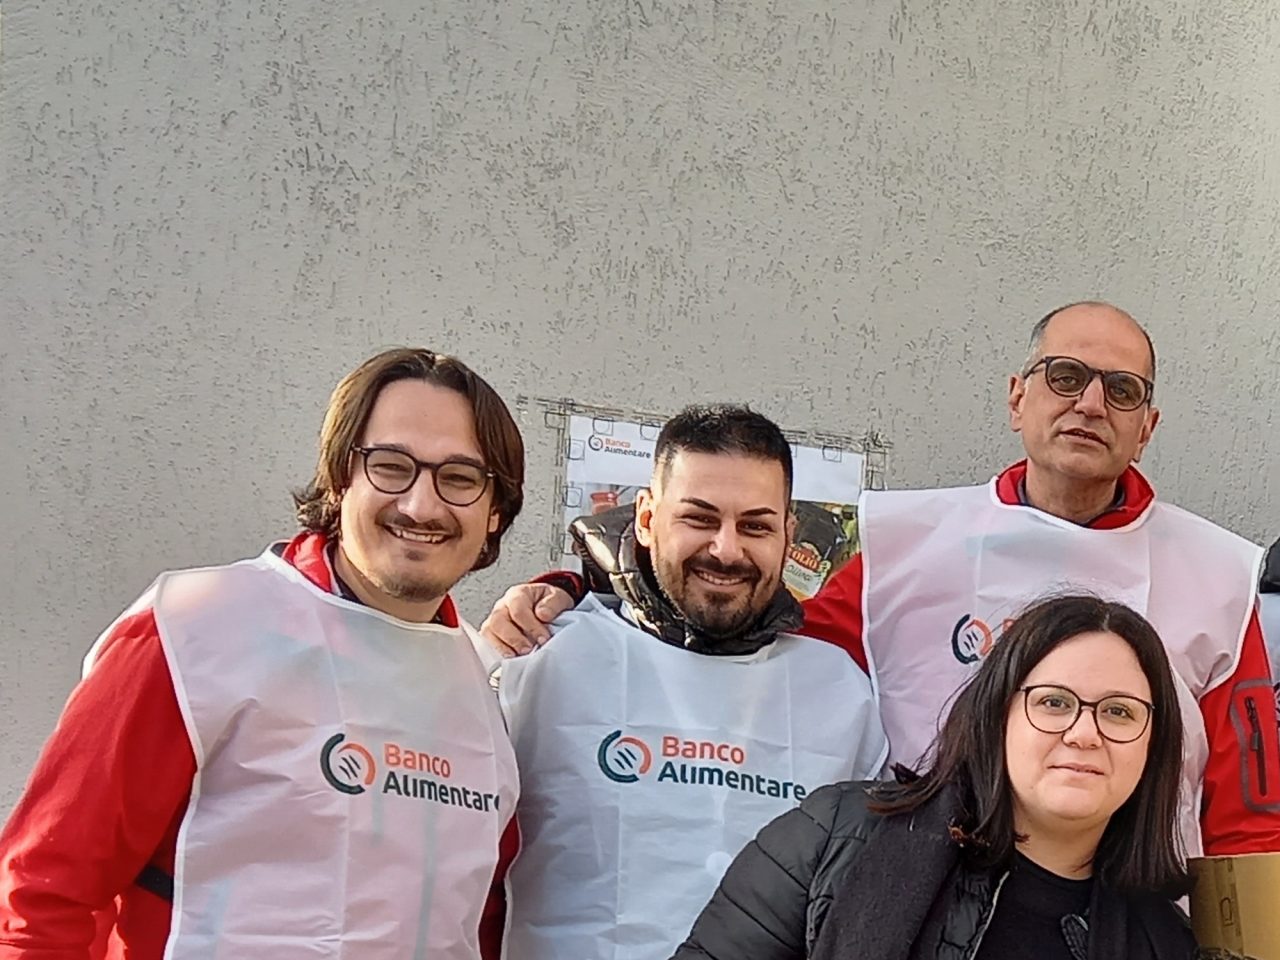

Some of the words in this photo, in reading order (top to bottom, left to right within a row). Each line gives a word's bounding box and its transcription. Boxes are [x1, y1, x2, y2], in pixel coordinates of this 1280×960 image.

[384, 743, 451, 779] Banco
[662, 736, 744, 765] Banco
[657, 761, 806, 801] Alimentare
